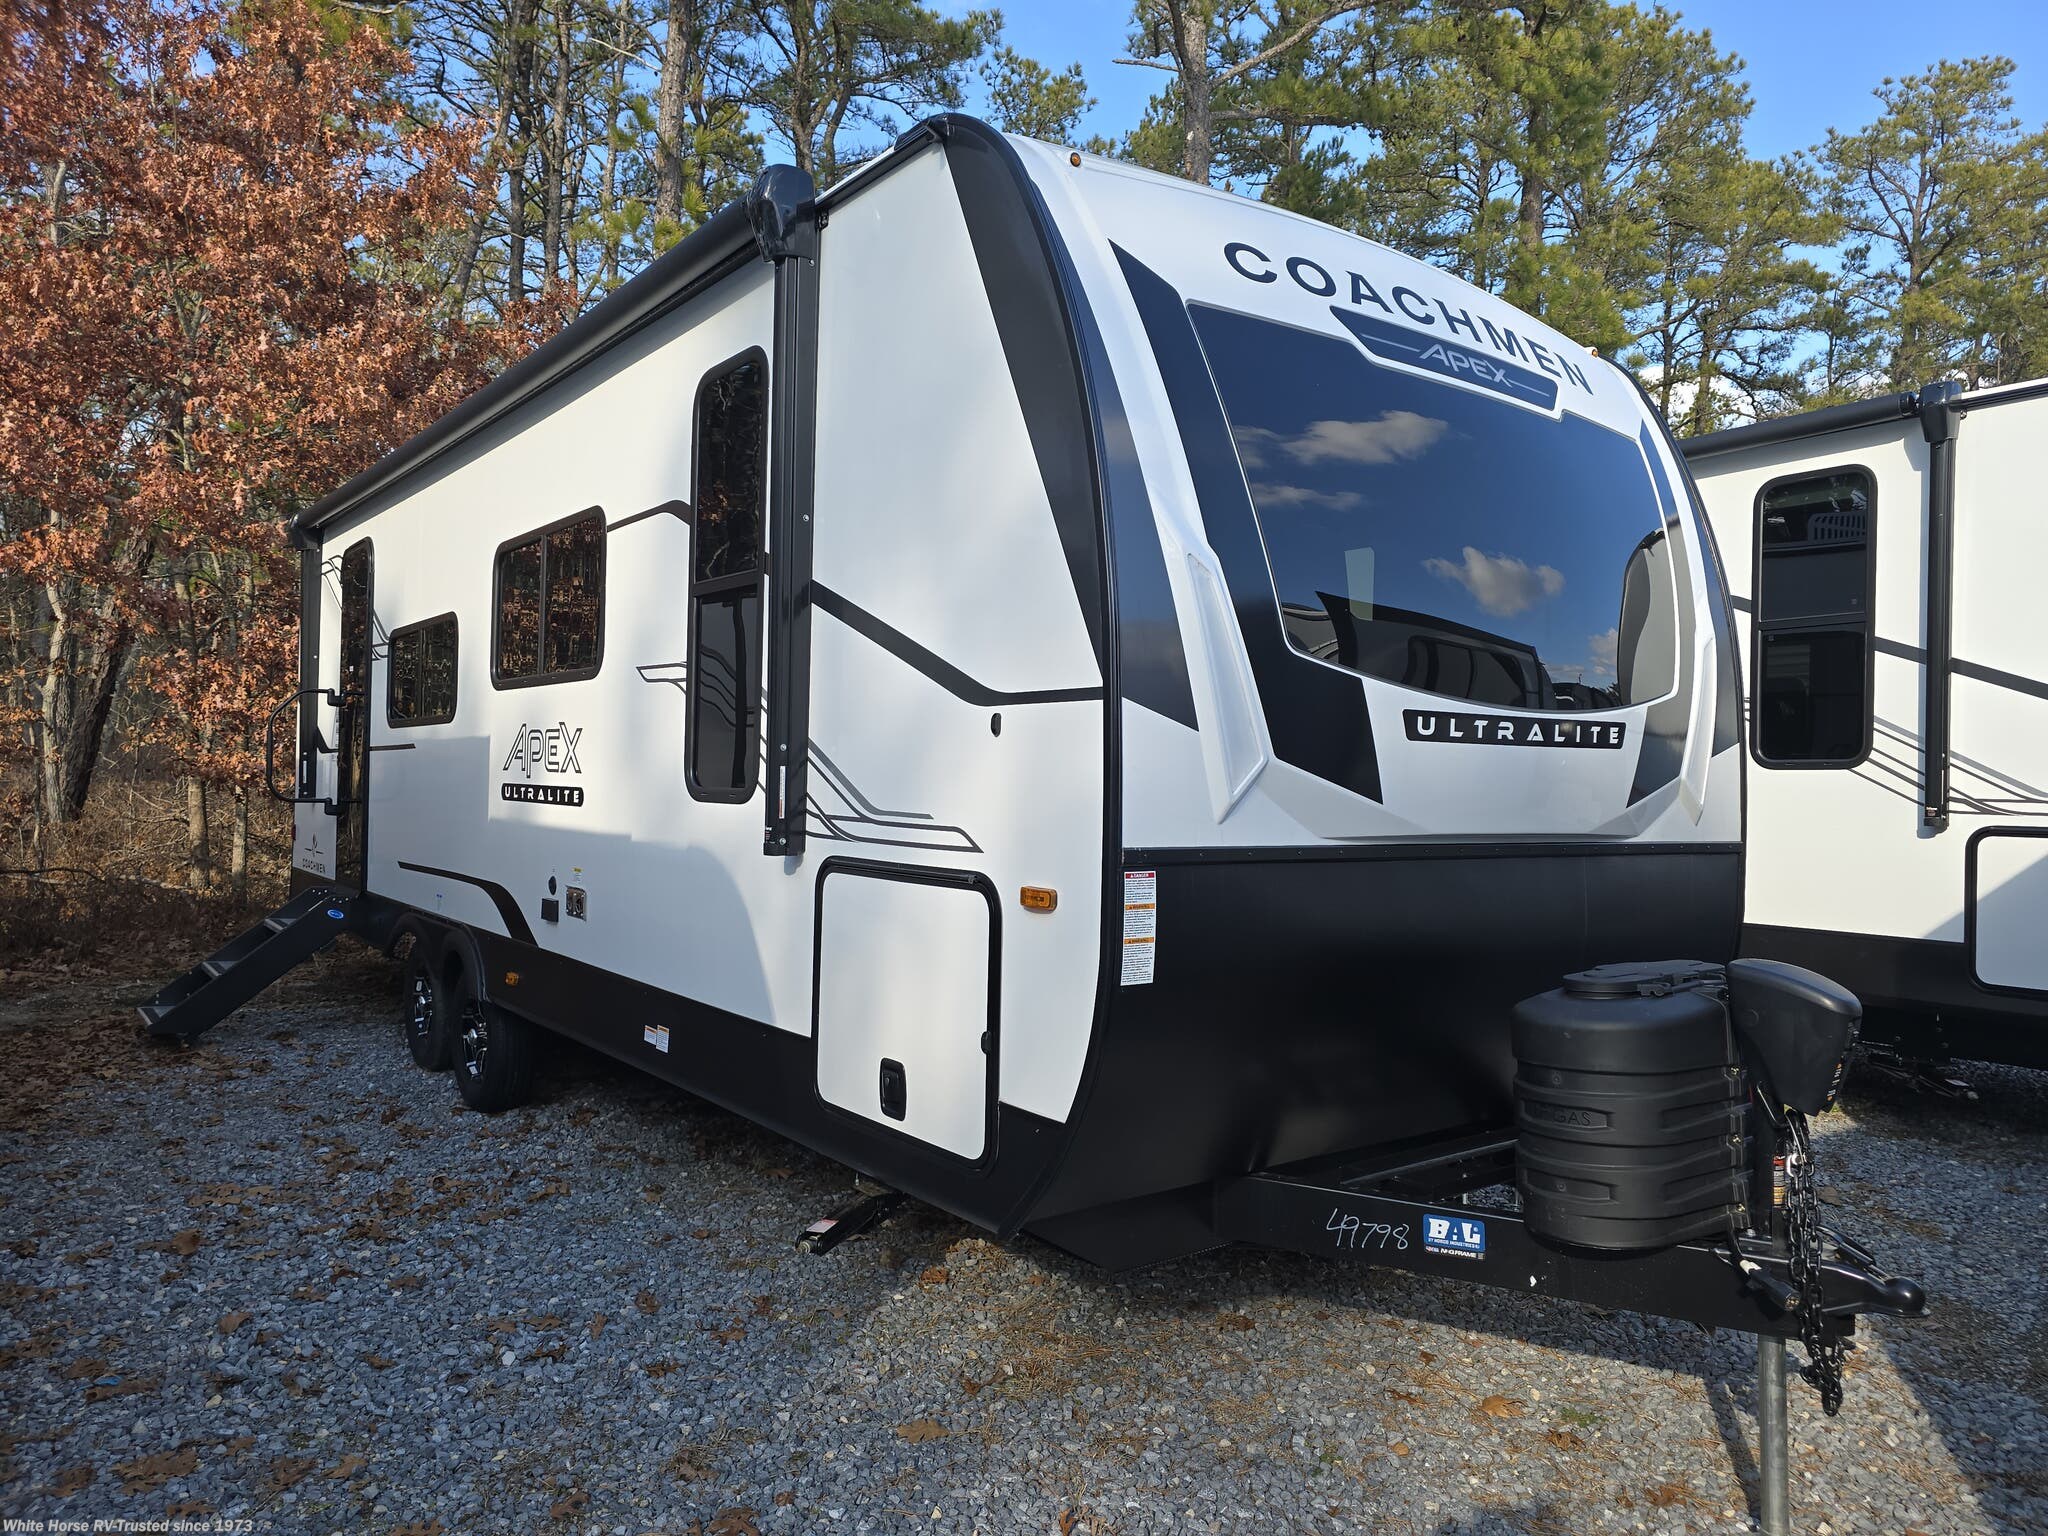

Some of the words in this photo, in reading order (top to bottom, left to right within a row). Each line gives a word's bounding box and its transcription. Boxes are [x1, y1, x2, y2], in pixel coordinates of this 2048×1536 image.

[1224, 242, 1593, 395] COACHMEN
[1419, 344, 1512, 388] APEX
[503, 722, 583, 778] APEX
[1417, 716, 1620, 744] ULTRALITE
[504, 786, 580, 804] ULTRALITE
[1326, 1208, 1409, 1250] 49798
[1428, 1218, 1480, 1244] BAL
